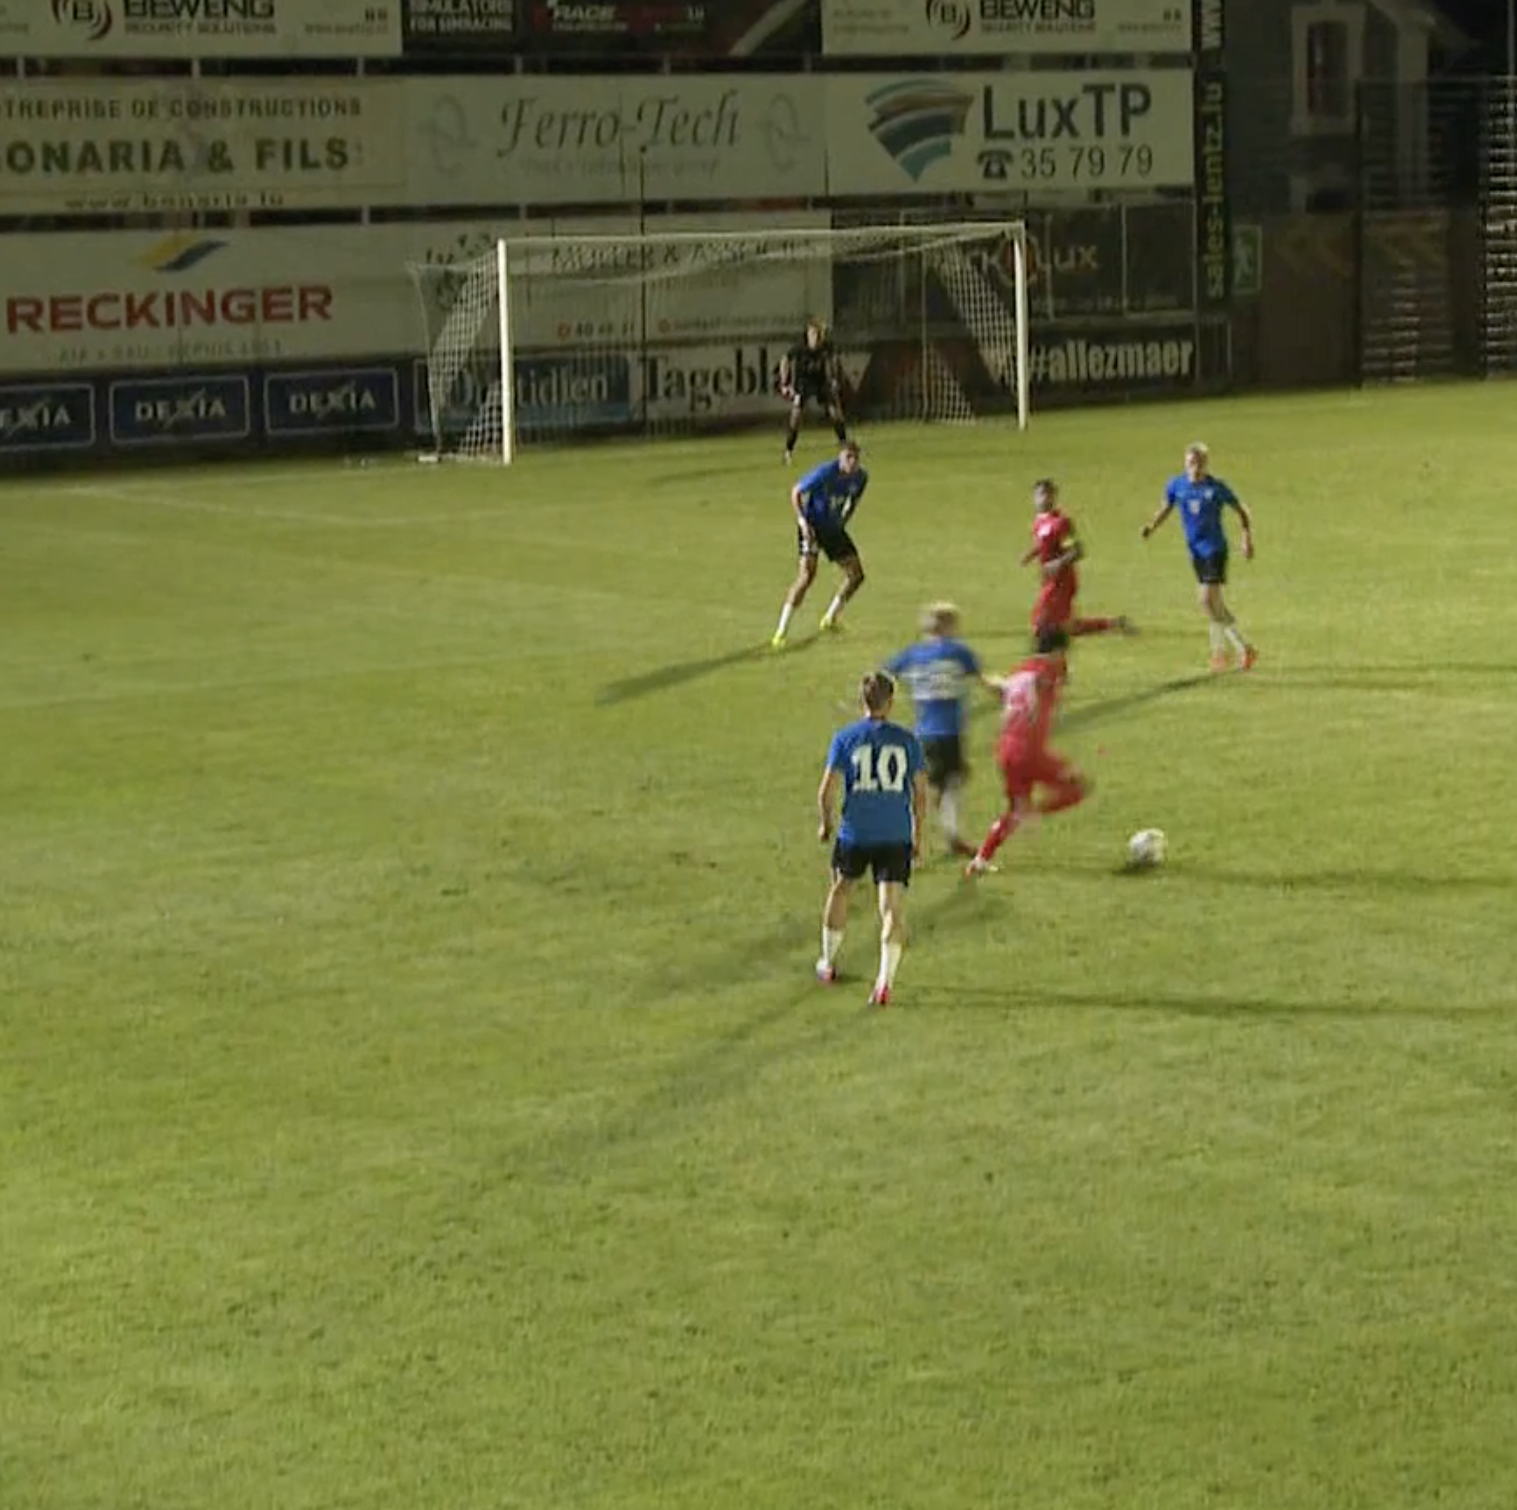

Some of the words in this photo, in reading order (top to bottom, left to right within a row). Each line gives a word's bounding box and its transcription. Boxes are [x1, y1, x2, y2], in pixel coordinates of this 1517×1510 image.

[0, 98, 121, 120] TREPRISE
[131, 98, 159, 118] DE
[169, 96, 362, 118] CONSTRUCTIONS
[982, 81, 1153, 140] LuxTP
[0, 138, 185, 173] ONARIA
[206, 139, 234, 174] &
[255, 137, 350, 171] FILS
[1019, 147, 1058, 178] 35
[1068, 146, 1106, 177] 79
[1119, 144, 1154, 176] 79
[6, 285, 334, 334] RECKINGER
[0, 400, 72, 428] EXIA
[134, 390, 228, 425] DEXIA
[288, 383, 376, 419] DEXIA
[851, 743, 908, 793] 10
